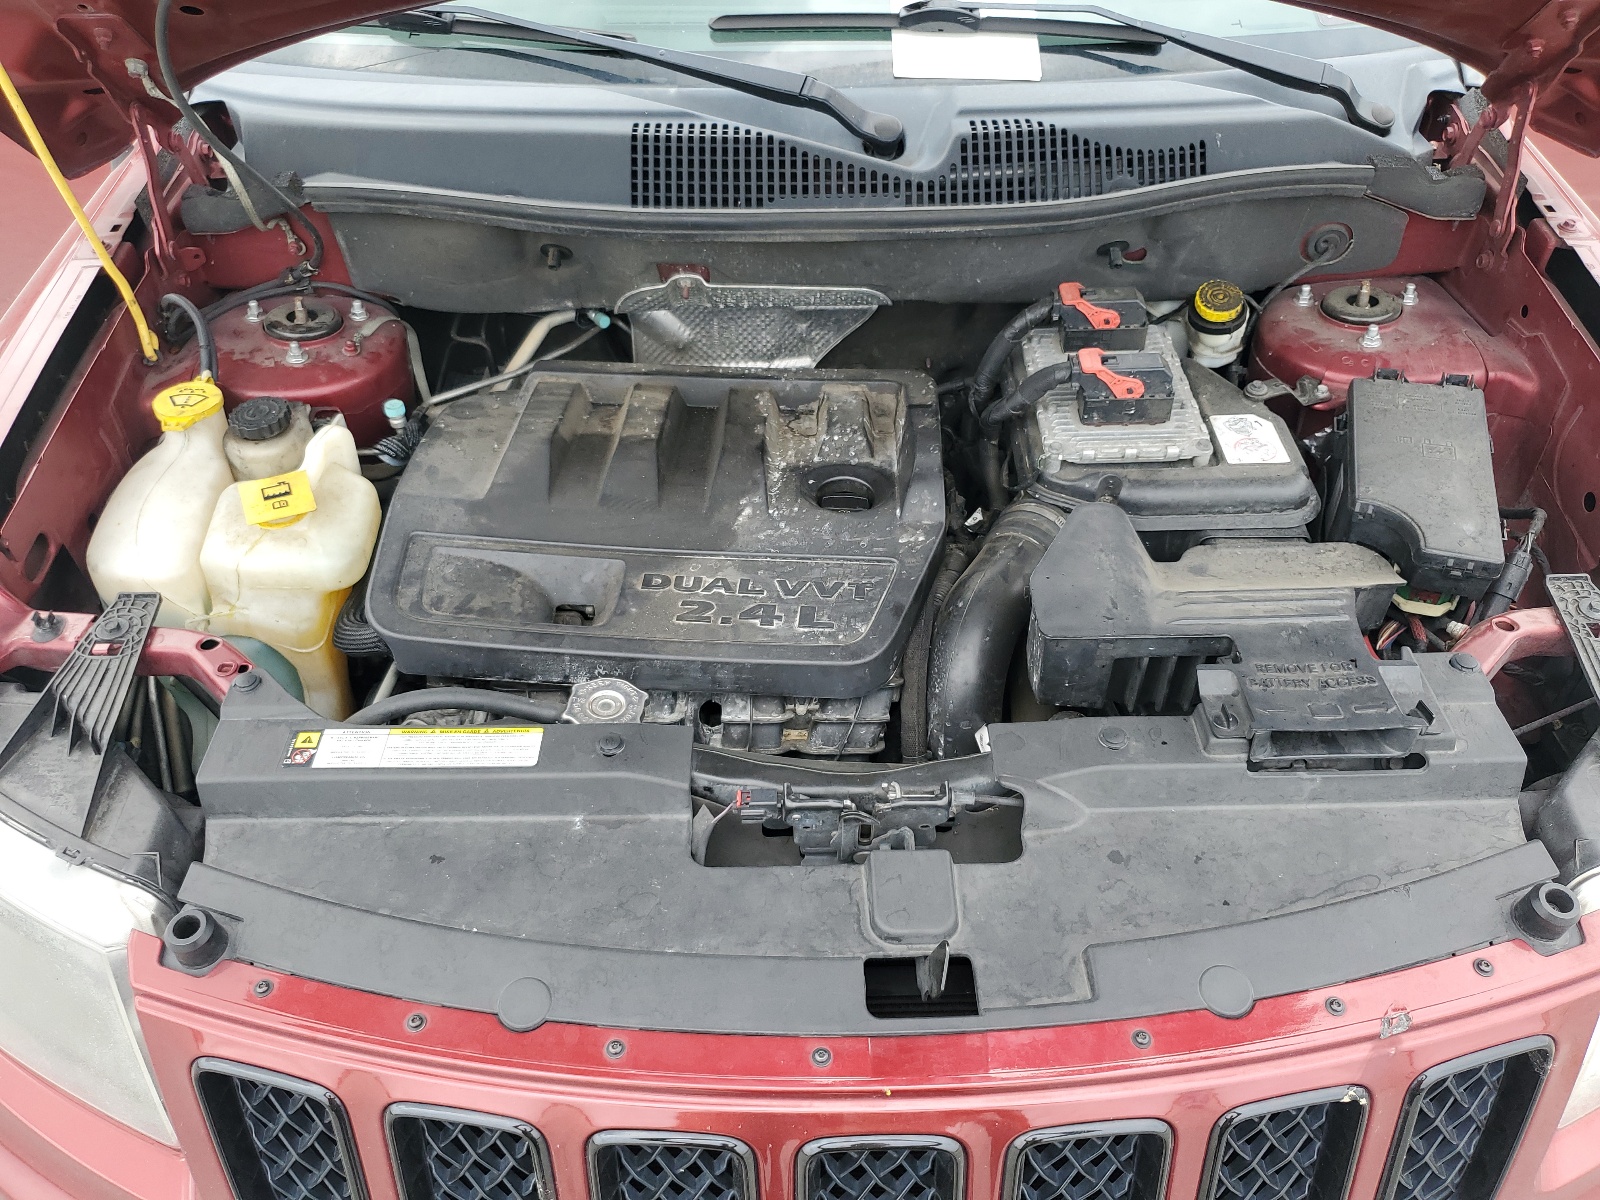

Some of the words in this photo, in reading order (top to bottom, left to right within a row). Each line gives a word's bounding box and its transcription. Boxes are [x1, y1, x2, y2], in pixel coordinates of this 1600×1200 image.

[640, 573, 766, 596] DUAL
[775, 578, 875, 600] VVT
[1254, 662, 1318, 674] REMOVE
[1321, 660, 1353, 673] FOR
[1248, 677, 1311, 688] BATTERY
[1317, 675, 1378, 689] ACCESS
